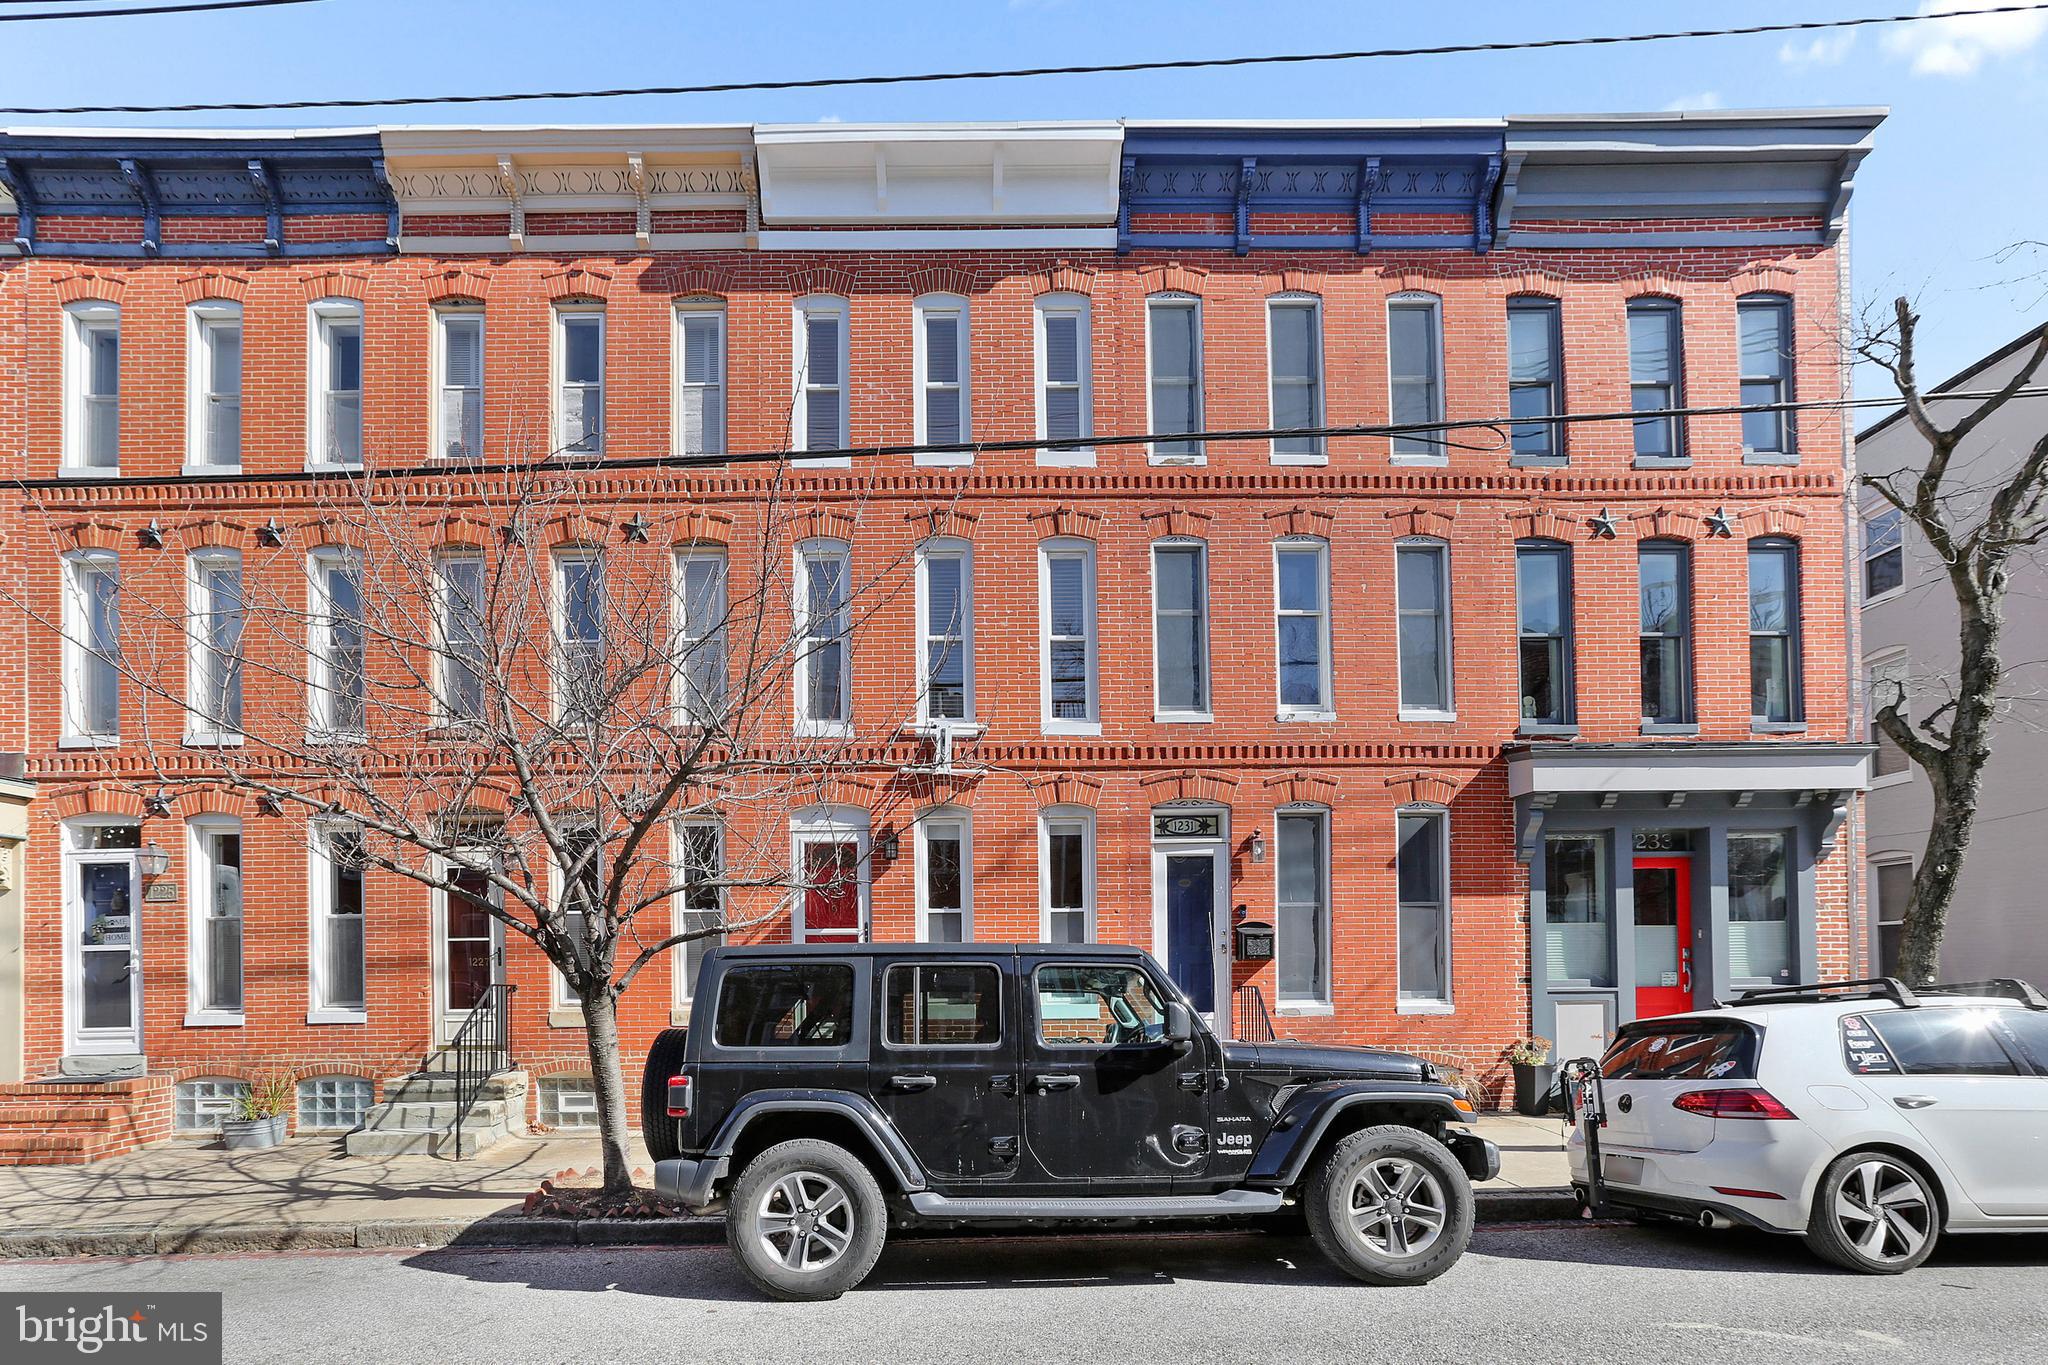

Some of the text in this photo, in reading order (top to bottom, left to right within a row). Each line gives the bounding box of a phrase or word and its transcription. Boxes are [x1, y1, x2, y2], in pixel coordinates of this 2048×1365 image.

[1173, 821, 1194, 831] 1231
[149, 885, 175, 898] 1225
[1217, 1132, 1253, 1147] Jeep
